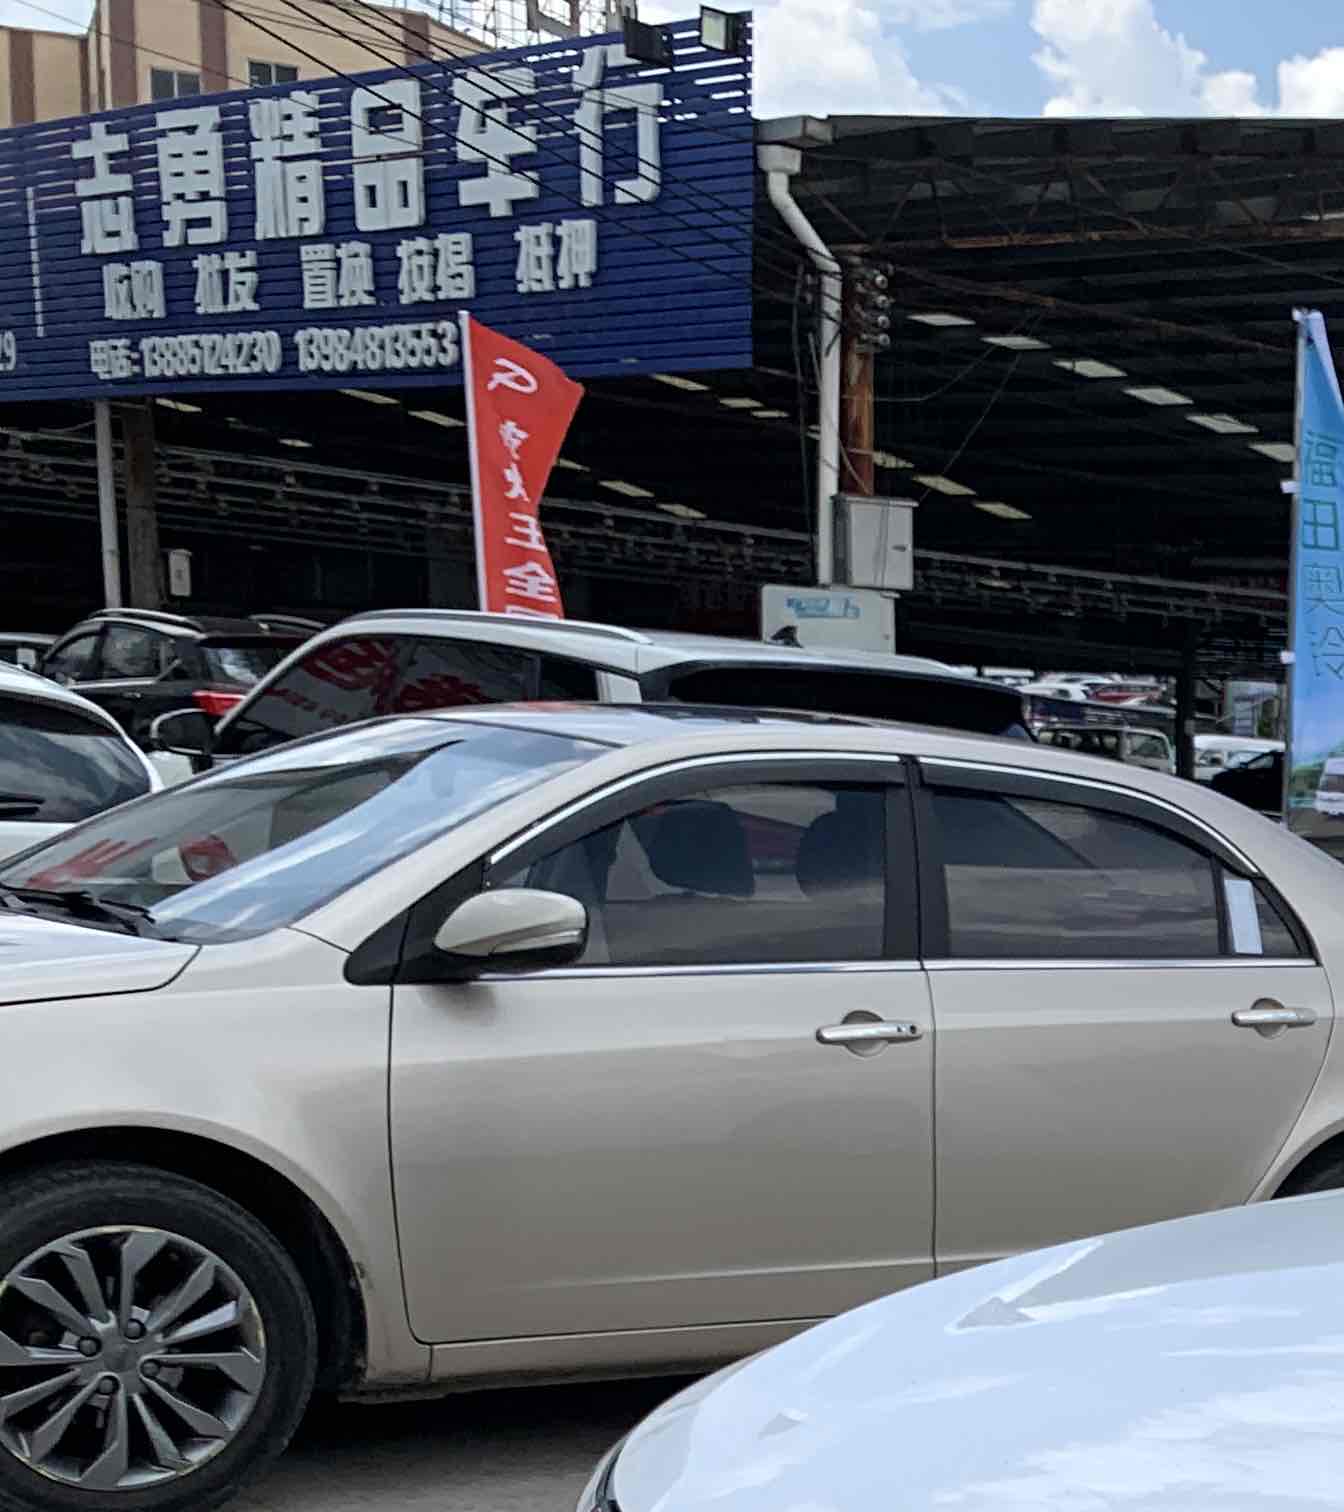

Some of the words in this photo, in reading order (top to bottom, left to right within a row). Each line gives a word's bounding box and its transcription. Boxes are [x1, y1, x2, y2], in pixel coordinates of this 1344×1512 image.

[300, 240, 376, 309] 置换
[397, 233, 476, 304] 按揭
[515, 219, 597, 292] 抵押
